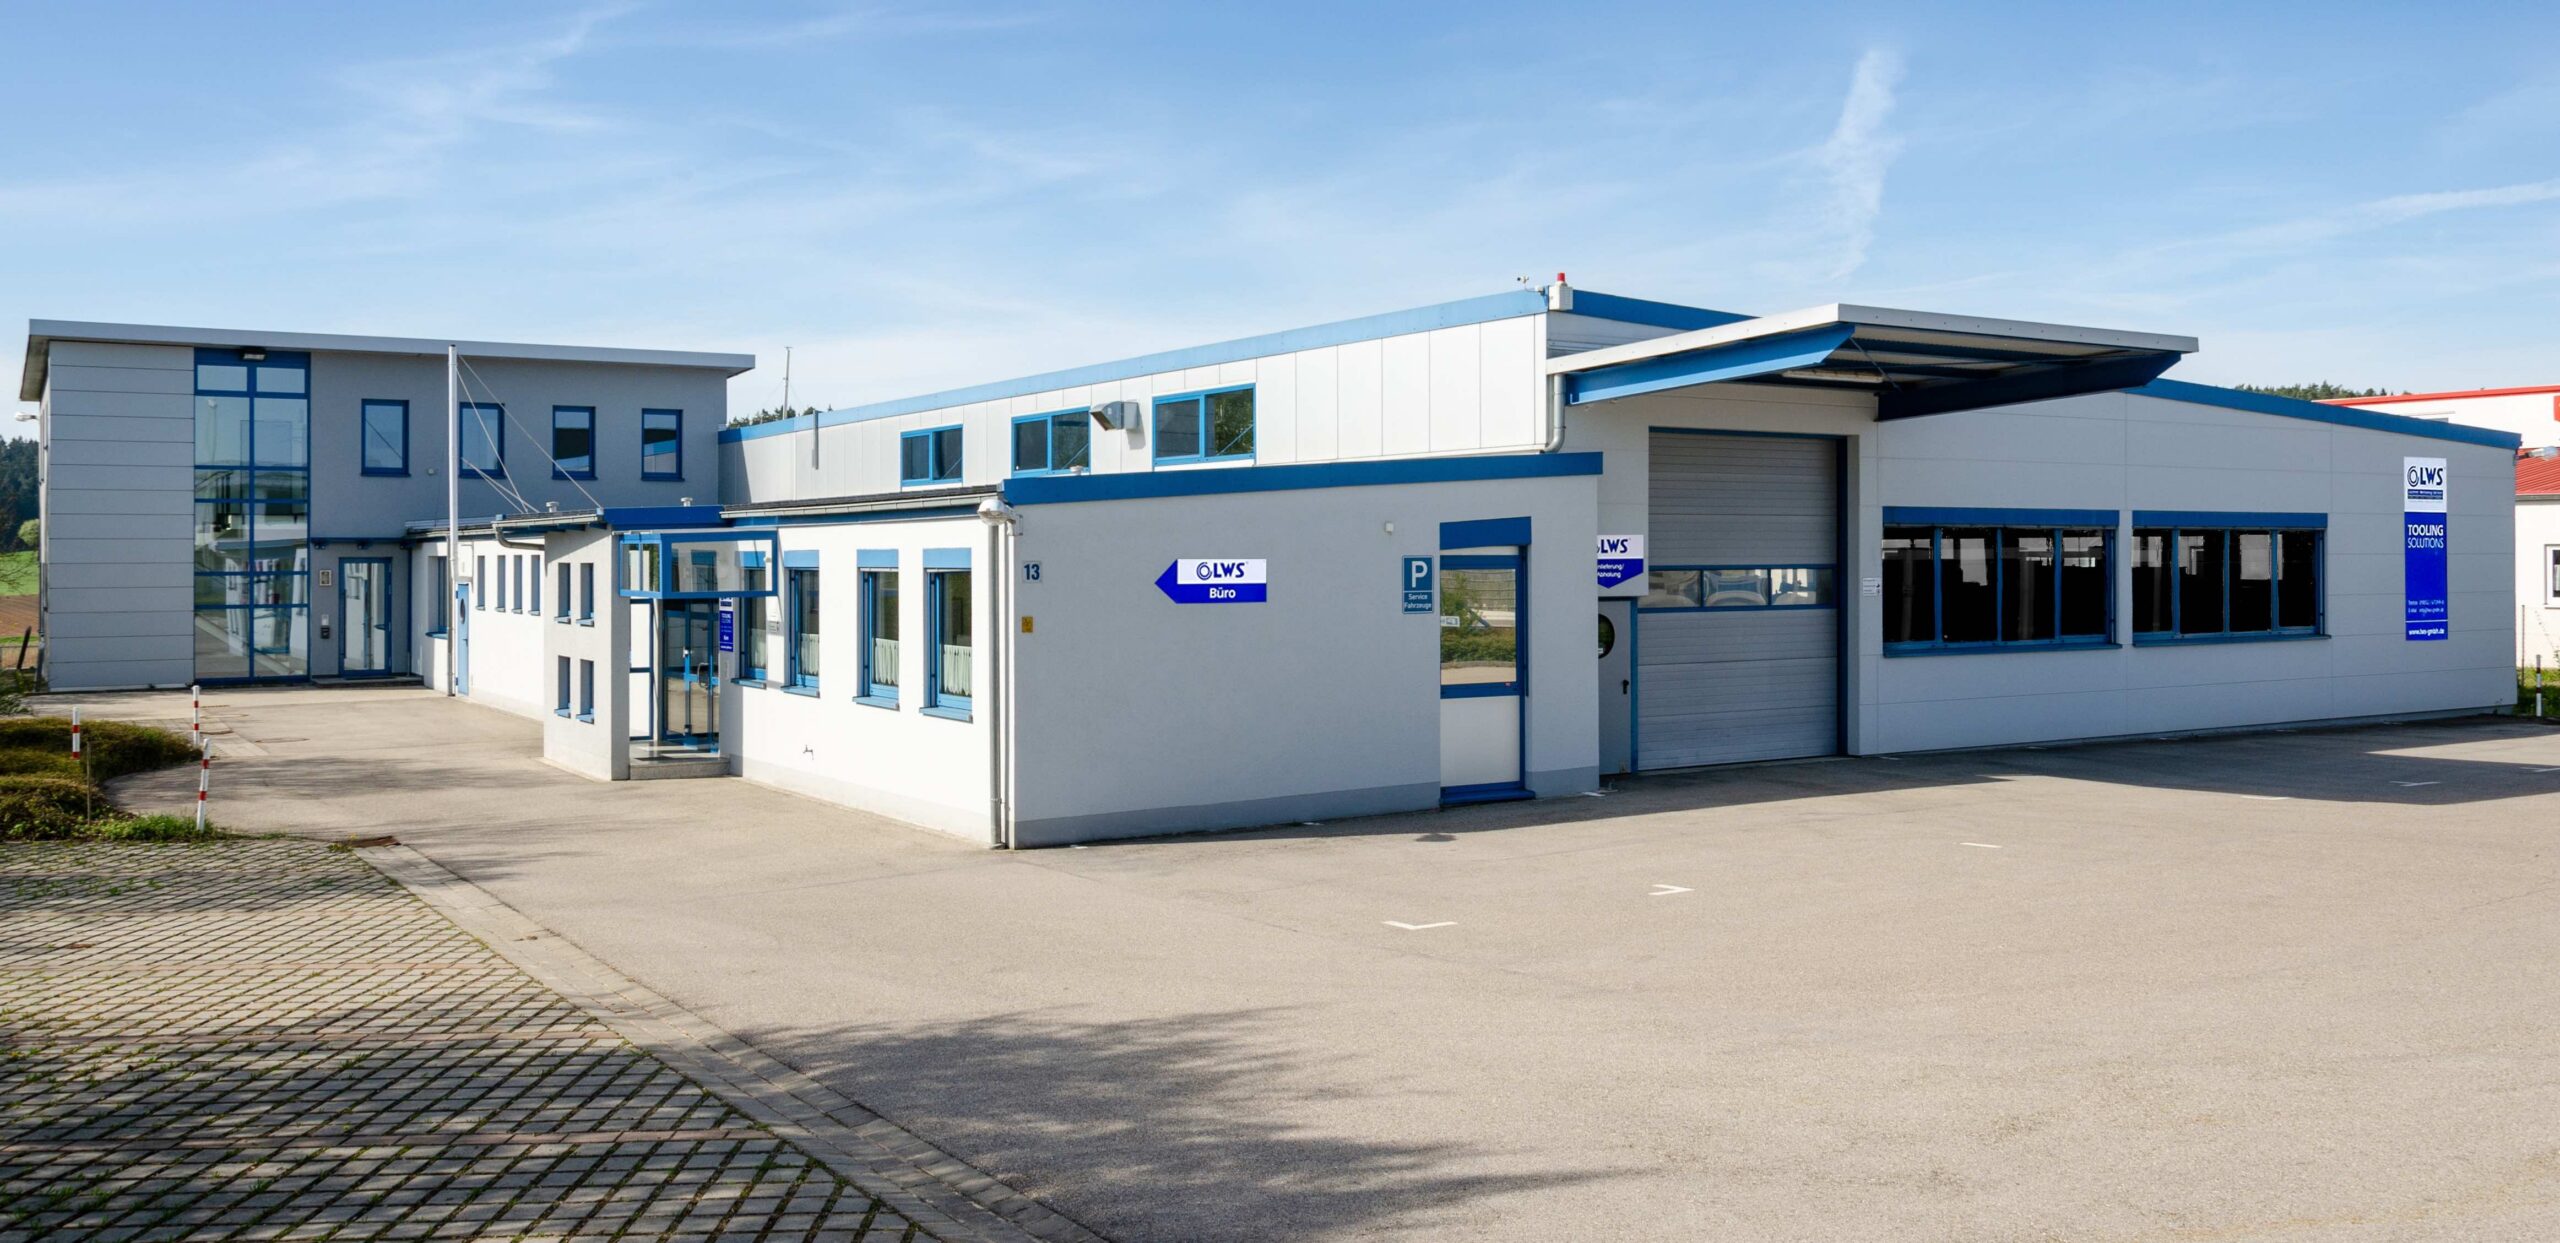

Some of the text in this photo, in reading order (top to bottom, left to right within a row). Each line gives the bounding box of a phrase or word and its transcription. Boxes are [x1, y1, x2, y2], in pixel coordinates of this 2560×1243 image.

[2420, 467, 2443, 485] LWS
[2407, 524, 2443, 535] TOOLING
[1600, 539, 1628, 553] LWS
[2407, 537, 2443, 548] SOLUTIONS
[1023, 563, 1040, 580] 13
[1213, 562, 1245, 578] LWS
[1411, 560, 1427, 588] P
[1209, 587, 1236, 599] Büro
